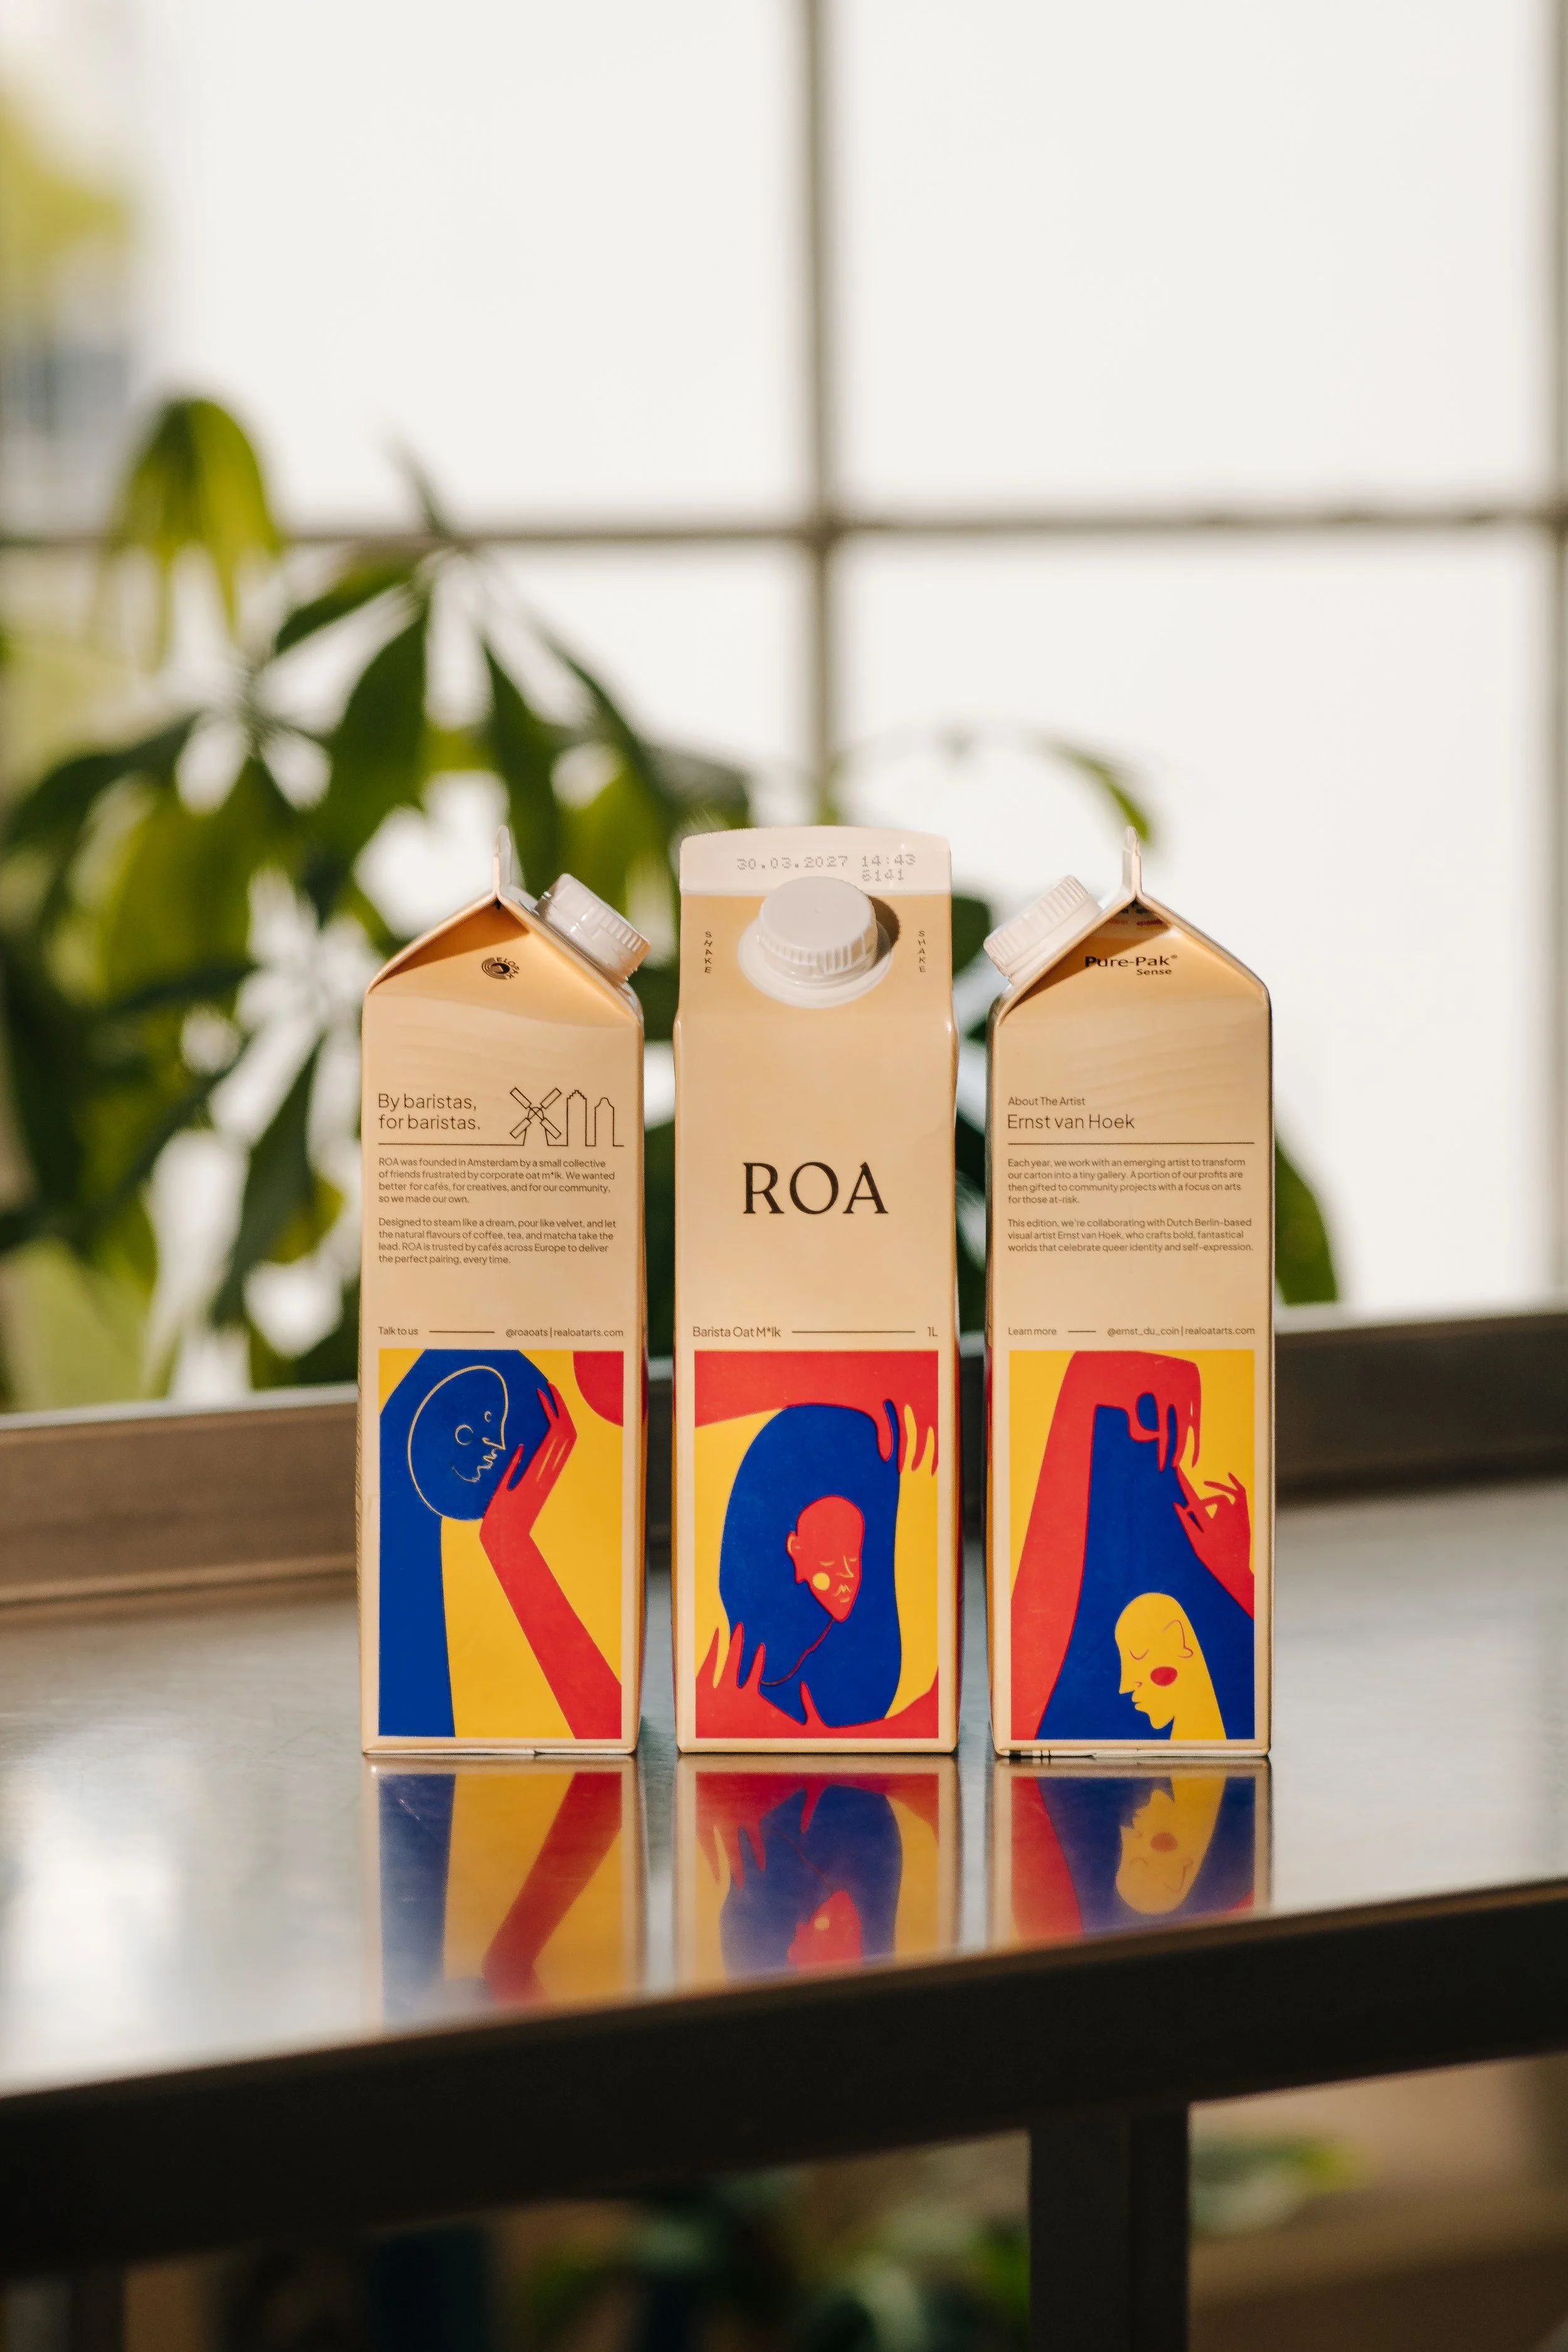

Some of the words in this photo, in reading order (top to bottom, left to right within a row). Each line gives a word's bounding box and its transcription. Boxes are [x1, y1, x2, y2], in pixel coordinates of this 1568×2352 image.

[737, 855, 849, 871] 30.03.2027
[862, 854, 916, 867] 14:43
[704, 931, 713, 974] SHAKE
[918, 930, 927, 973] SHAKE
[378, 1093, 400, 1113] By
[403, 1093, 476, 1111] baristas,
[1008, 1096, 1039, 1106] About
[1040, 1096, 1058, 1106] The
[1059, 1096, 1085, 1106] Artist
[379, 1114, 404, 1129] for
[408, 1115, 480, 1130] baristas.
[1008, 1114, 1051, 1129] Ernst
[1054, 1118, 1084, 1128] van
[1089, 1114, 1135, 1128] Hoek
[379, 1157, 399, 1166] ROA
[419, 1158, 457, 1167] founded
[467, 1158, 518, 1168] Amsterdam
[519, 1158, 531, 1168] by
[539, 1159, 562, 1168] small
[563, 1159, 606, 1168] collective
[1008, 1158, 1030, 1168] Each
[1054, 1159, 1067, 1168] we
[1068, 1159, 1091, 1168] work
[1092, 1158, 1110, 1167] with
[1123, 1158, 1167, 1168] emerging
[1167, 1158, 1190, 1168] artist
[1201, 1158, 1245, 1167] transform
[378, 1170, 389, 1179] of
[389, 1170, 421, 1179] friends
[421, 1170, 467, 1179] frustrated
[467, 1170, 479, 1180] by
[480, 1171, 524, 1180] corporate
[525, 1172, 541, 1180] oat
[564, 1170, 580, 1180] We
[581, 1172, 615, 1180] wanted
[1024, 1171, 1054, 1180] carton
[1054, 1171, 1072, 1179] into
[1078, 1170, 1096, 1181] tiny
[1138, 1170, 1171, 1181] portion
[1172, 1170, 1182, 1179] of
[1183, 1171, 1198, 1179] our
[1199, 1170, 1228, 1180] profits
[378, 1182, 407, 1192] better
[409, 1182, 423, 1190] for
[452, 1182, 465, 1191] for
[511, 1183, 529, 1192] and
[529, 1183, 543, 1192] for
[543, 1184, 558, 1192] our
[743, 1162, 888, 1214] ROA
[1007, 1183, 1028, 1194] then
[1029, 1183, 1056, 1194] gifted
[1069, 1183, 1119, 1193] community
[1120, 1183, 1157, 1193] projects
[1158, 1183, 1177, 1191] with
[1185, 1183, 1210, 1192] focus
[405, 1194, 431, 1204] made
[1007, 1195, 1022, 1204] for
[1022, 1195, 1048, 1204] those
[379, 1217, 421, 1227] Designed
[422, 1219, 432, 1227] to
[433, 1219, 462, 1227] steam
[463, 1218, 477, 1227] like
[540, 1219, 555, 1228] like
[586, 1219, 604, 1229] and
[605, 1219, 617, 1228] let
[1008, 1219, 1025, 1228] This
[1061, 1219, 1086, 1229] we're
[1086, 1219, 1145, 1229] collaborating
[1147, 1219, 1165, 1227] with
[1167, 1218, 1193, 1228] Dutch
[1194, 1218, 1252, 1228] Berlin-based
[379, 1229, 394, 1239] the
[395, 1230, 425, 1239] natural
[425, 1230, 462, 1239] flavours
[462, 1230, 473, 1239] of
[525, 1231, 543, 1240] and
[544, 1231, 577, 1240] matcha
[578, 1231, 598, 1240] take
[599, 1232, 613, 1240] the
[1008, 1231, 1033, 1240] visual
[1034, 1231, 1057, 1239] artist
[1057, 1231, 1080, 1239] Ernst
[1125, 1231, 1144, 1239] who
[1145, 1231, 1172, 1239] crafts
[1197, 1231, 1243, 1240] fantastical
[402, 1242, 423, 1251] ROA
[432, 1242, 464, 1251] trusted
[465, 1242, 477, 1253] by
[477, 1242, 503, 1252] cafés
[534, 1243, 566, 1253] Europe
[566, 1244, 578, 1253] to
[578, 1244, 608, 1253] deliver
[1008, 1243, 1037, 1252] worlds
[1038, 1243, 1057, 1251] that
[1058, 1243, 1101, 1254] celebrate
[1102, 1244, 1128, 1253] queer
[1129, 1243, 1163, 1253] identity
[1165, 1243, 1181, 1251] and
[379, 1254, 393, 1263] the
[395, 1254, 428, 1264] perfect
[463, 1254, 489, 1264] every
[378, 1327, 396, 1335] Talk
[506, 1328, 548, 1338] @roaoats
[554, 1328, 623, 1337] realoatarts.com
[693, 1326, 731, 1337] Barista
[733, 1327, 755, 1337] Oat
[928, 1327, 938, 1337] 1L
[1009, 1327, 1032, 1335] Learn
[1108, 1327, 1179, 1337] @ernst_du_coin
[1185, 1327, 1255, 1335] realoatarts.com
